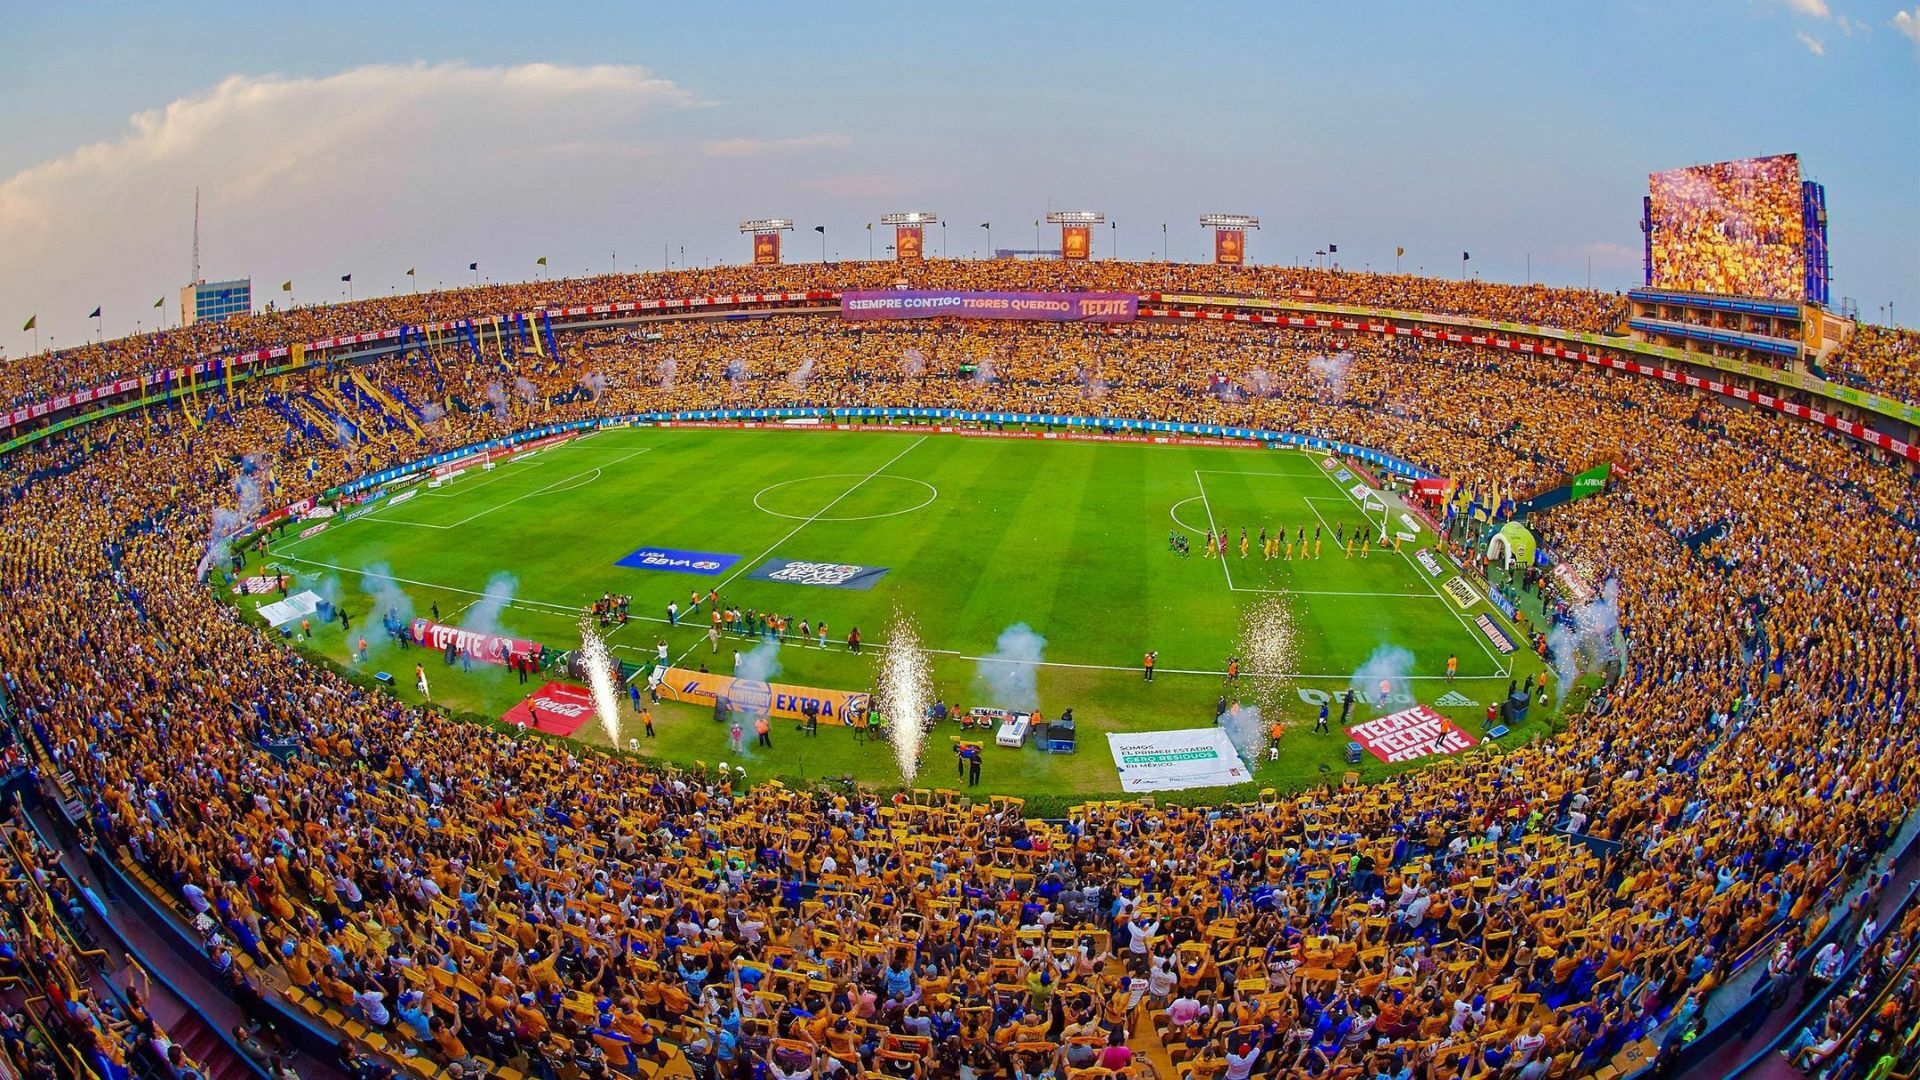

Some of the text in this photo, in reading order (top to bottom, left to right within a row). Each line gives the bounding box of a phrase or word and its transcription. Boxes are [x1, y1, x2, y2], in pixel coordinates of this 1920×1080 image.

[849, 296, 1129, 316] SIEMPRE CONTIGO TIGRES QUERIDO TECATE
[75, 391, 92, 404] TECATE
[98, 385, 114, 398] TECATE
[121, 379, 138, 391] TECATE
[241, 352, 258, 364] TECATE
[270, 347, 288, 358] TECATE
[642, 557, 690, 567] BBVA
[1446, 577, 1475, 606] BARDAHL
[430, 624, 487, 657] TECATE
[776, 693, 833, 717] EXTRA
[1433, 698, 1480, 707] adidas
[1351, 706, 1433, 740] TECATE
[1368, 718, 1447, 754] TECATE
[1160, 752, 1214, 761] RESIDUOS
[1173, 745, 1214, 753] ESTADIO
